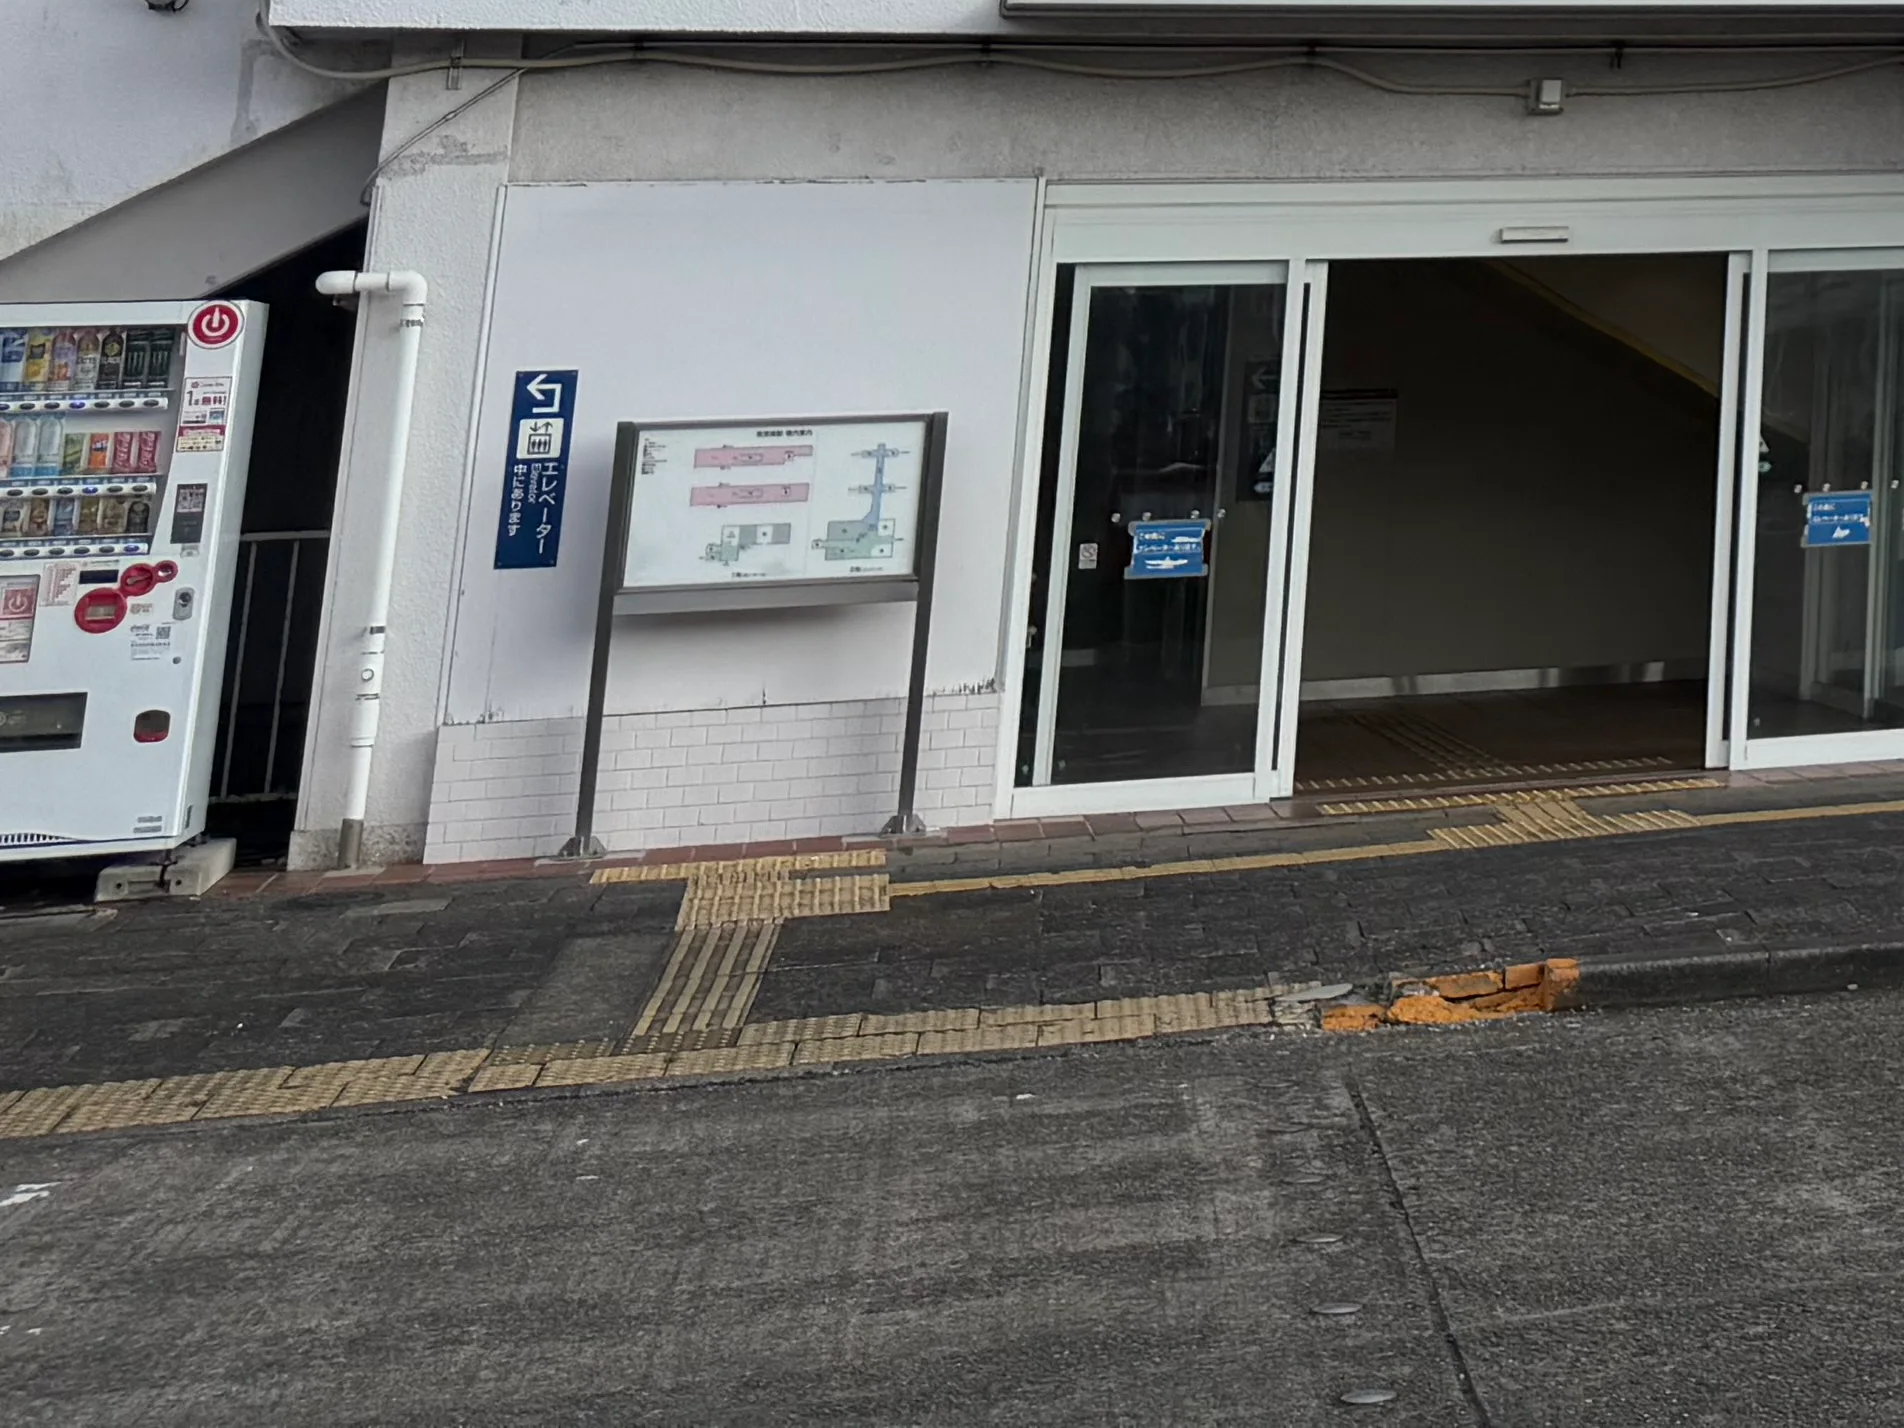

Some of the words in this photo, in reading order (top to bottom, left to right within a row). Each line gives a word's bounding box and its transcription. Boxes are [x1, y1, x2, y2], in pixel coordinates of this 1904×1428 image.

[536, 462, 559, 554] エレベーター
